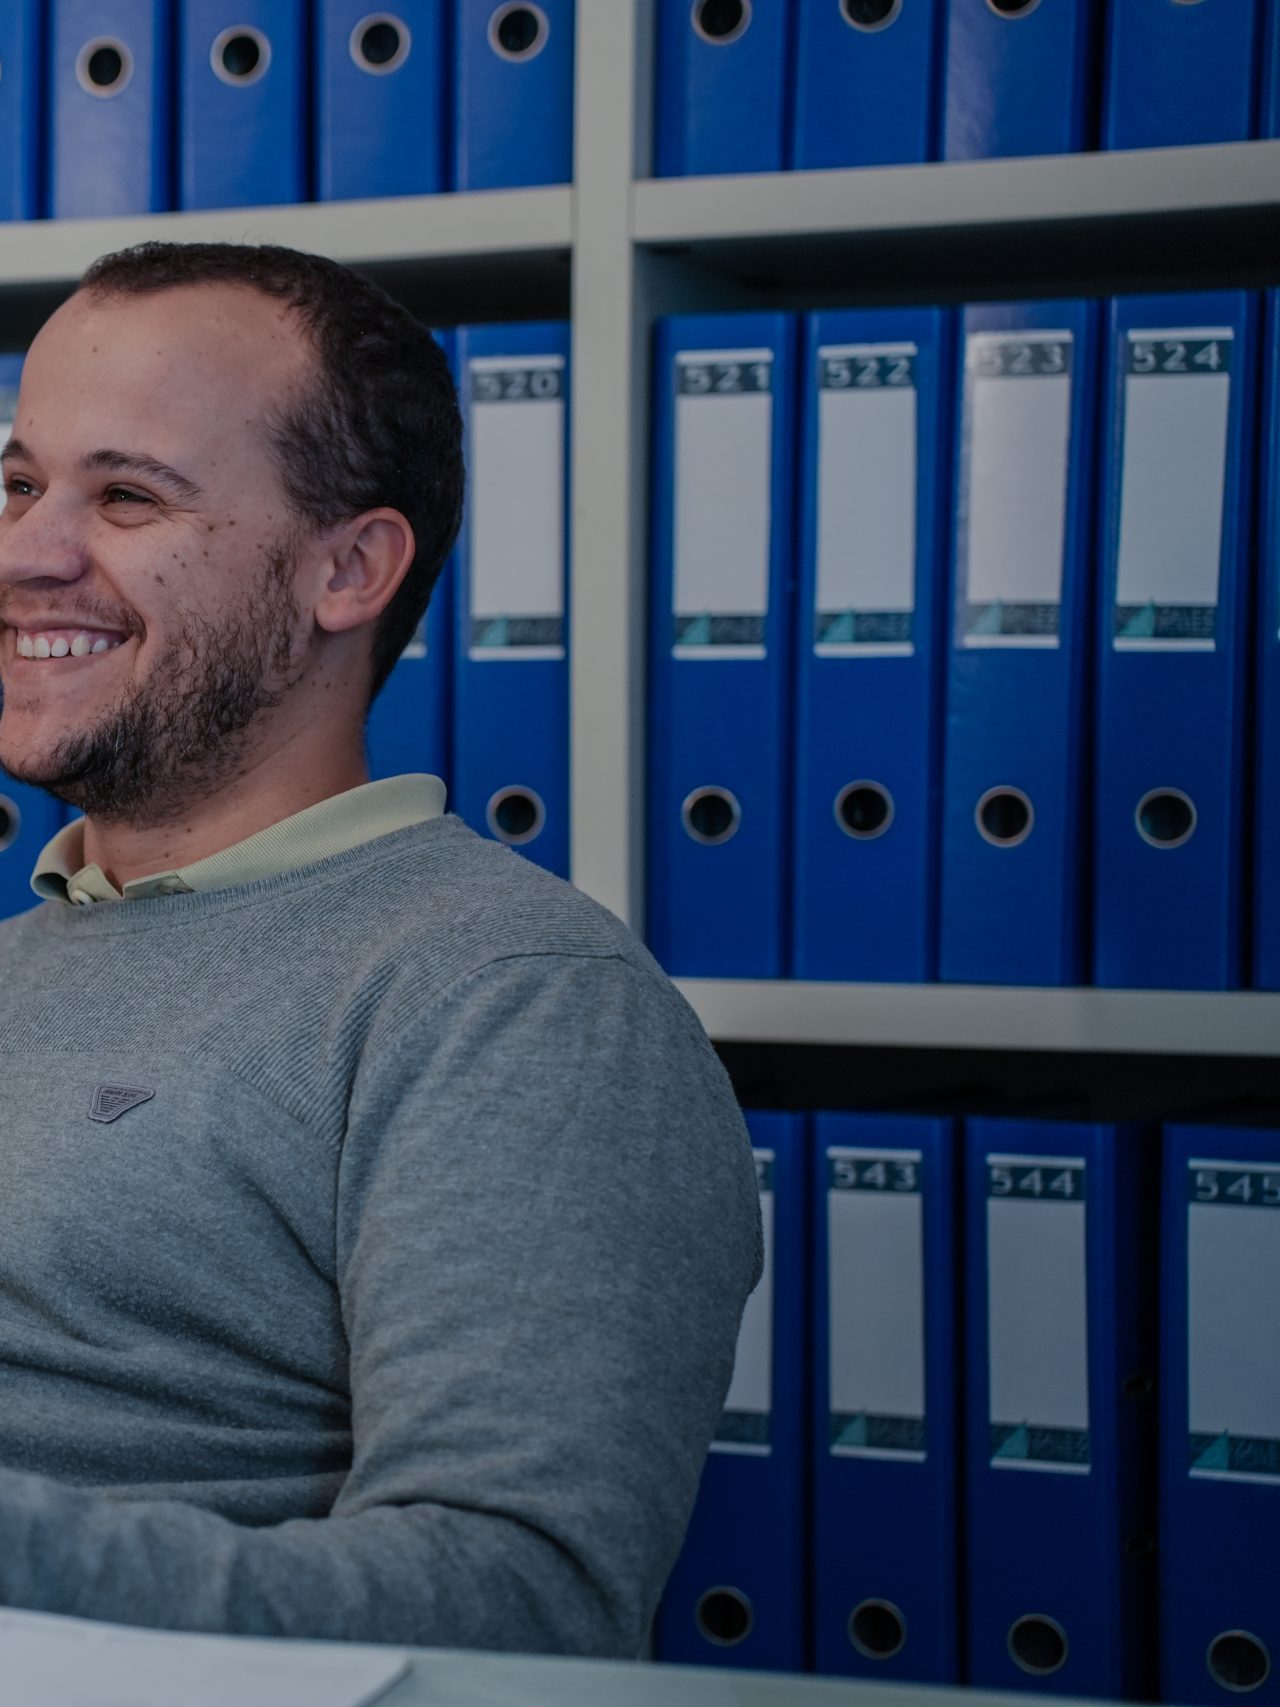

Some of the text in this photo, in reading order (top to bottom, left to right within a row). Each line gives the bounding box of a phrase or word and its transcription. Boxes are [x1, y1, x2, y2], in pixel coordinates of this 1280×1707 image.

[826, 356, 911, 387] 522
[982, 342, 1064, 374] 523
[1132, 341, 1221, 372] 524
[476, 370, 560, 399] 520
[685, 364, 769, 392] 521
[833, 1160, 916, 1190] 543
[990, 1168, 1075, 1198] 544
[1196, 1172, 1280, 1203] 545
